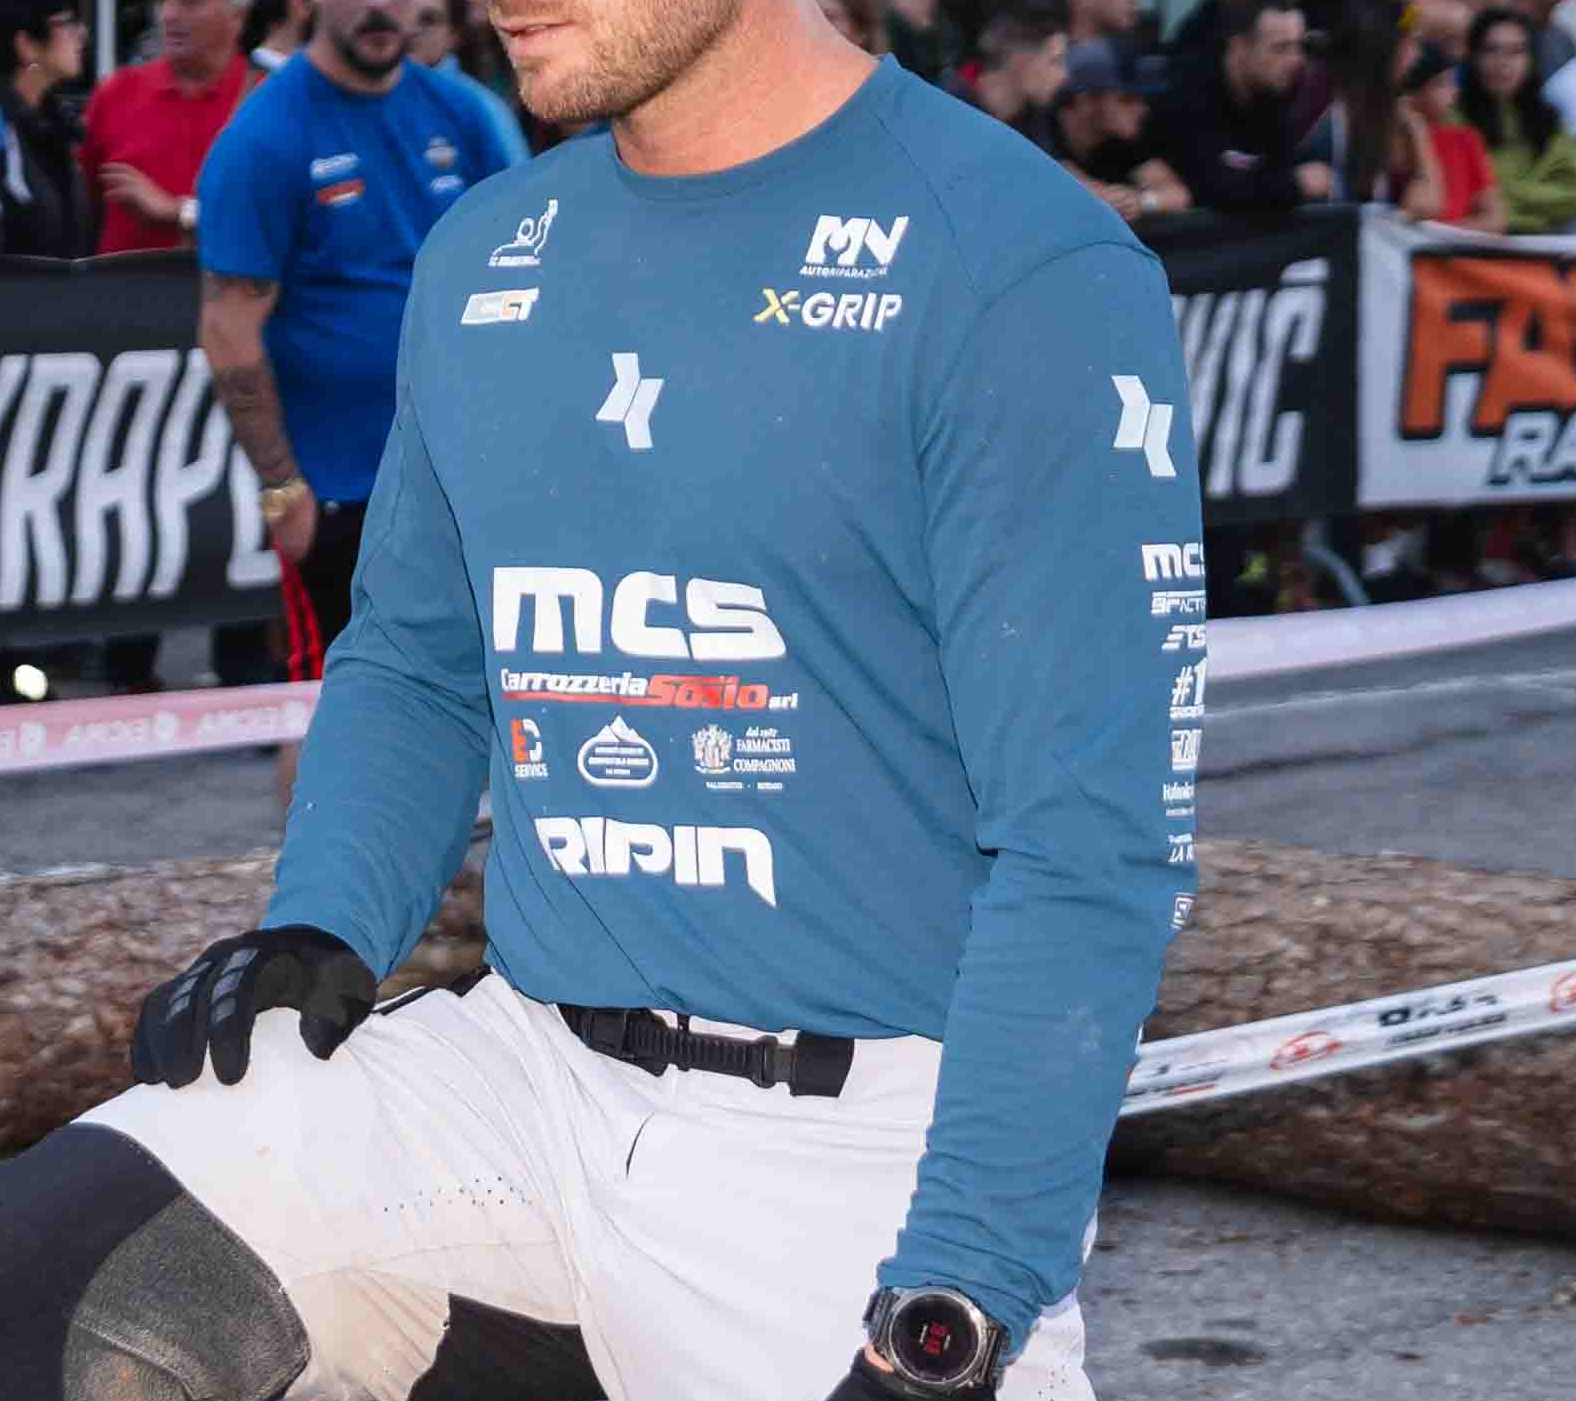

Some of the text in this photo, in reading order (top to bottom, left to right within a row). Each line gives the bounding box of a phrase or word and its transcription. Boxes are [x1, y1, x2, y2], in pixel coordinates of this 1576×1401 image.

[753, 288, 903, 333] X-GRIP
[501, 669, 648, 696] Carrozzeria
[735, 738, 791, 753] FARMACISTI
[733, 758, 797, 773] COMPAGNONI
